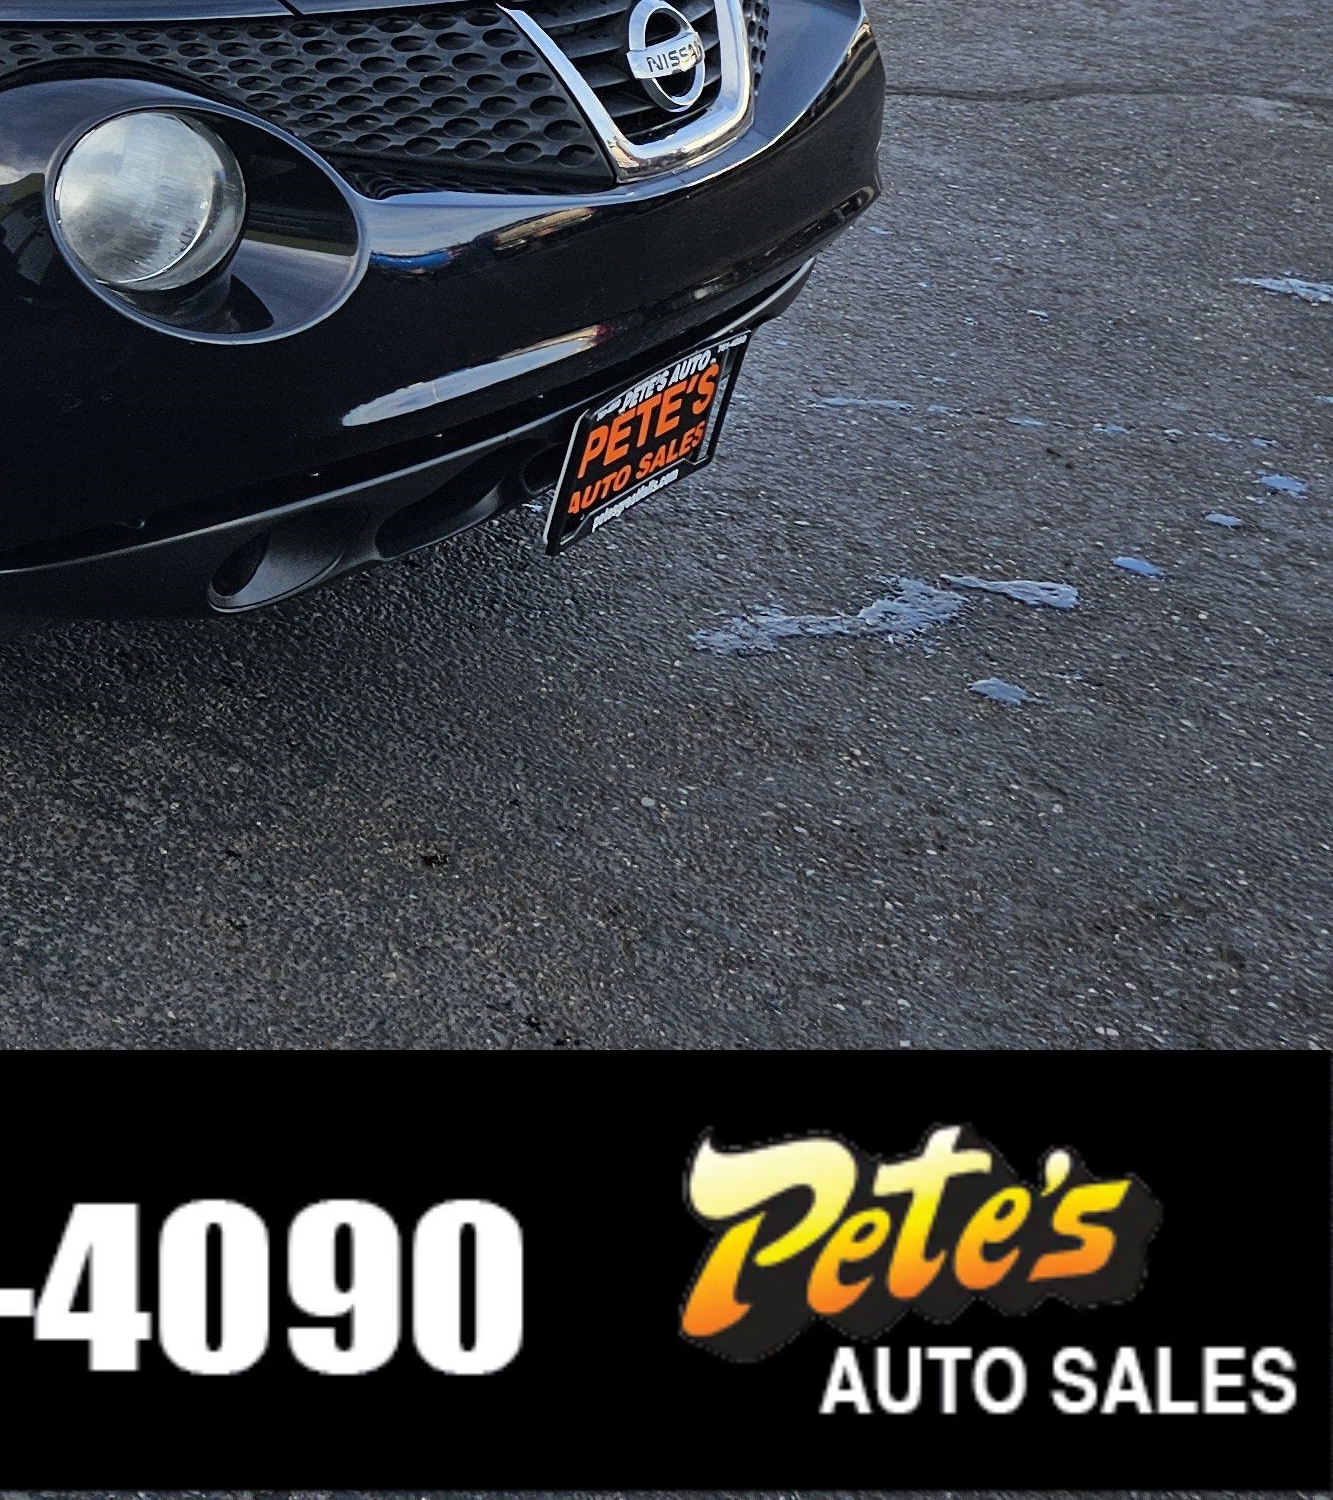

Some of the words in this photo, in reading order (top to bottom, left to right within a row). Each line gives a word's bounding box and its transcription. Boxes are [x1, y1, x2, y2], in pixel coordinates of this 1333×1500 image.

[577, 363, 721, 479] PETE'S
[618, 371, 670, 414] PETE'S
[669, 350, 712, 388] AUTO
[568, 464, 632, 514] AUTO
[636, 420, 707, 480] SALES
